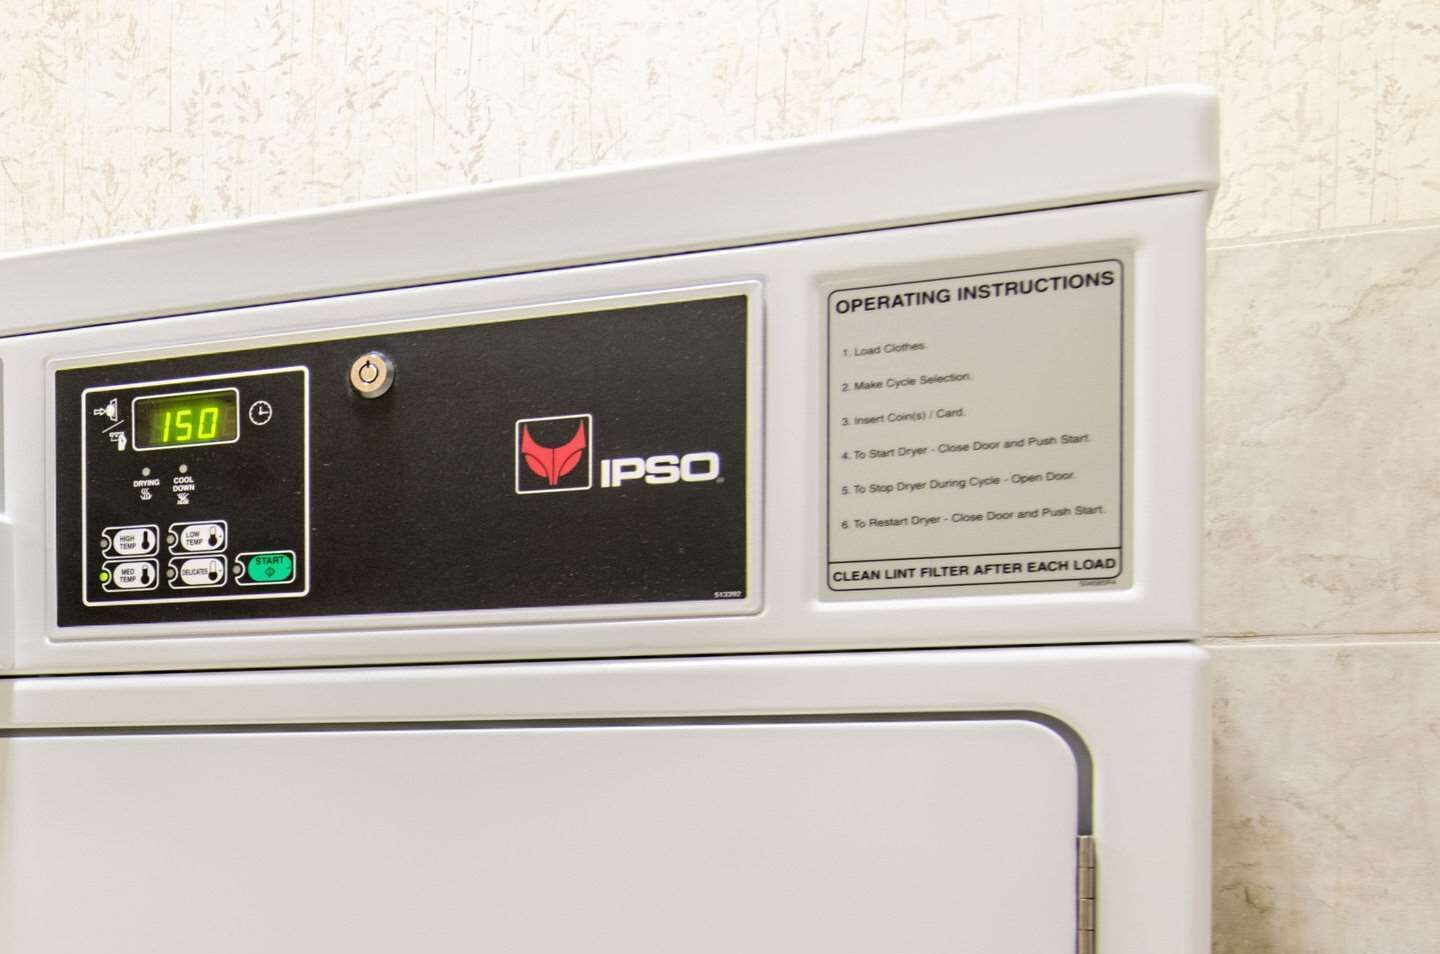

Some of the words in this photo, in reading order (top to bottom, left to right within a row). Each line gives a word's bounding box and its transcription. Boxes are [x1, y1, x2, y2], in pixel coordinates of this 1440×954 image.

[836, 289, 950, 314] OPERATING
[958, 270, 1114, 300] INSTRUCTIONS
[843, 348, 851, 357] 1.
[854, 346, 880, 357] Load
[884, 342, 927, 353] Clothes.
[842, 383, 851, 392] 2.
[854, 380, 882, 391] Make
[886, 378, 916, 389] Cycle
[920, 372, 974, 384] Selection.
[162, 407, 219, 442] 150
[842, 418, 851, 426] 3.
[854, 414, 884, 425] Insert
[888, 411, 926, 422] Coin(s)
[936, 407, 966, 419] Card.
[841, 452, 850, 460] 4.
[854, 451, 866, 459] To
[869, 449, 894, 458] Start
[898, 447, 927, 458] Dryer
[938, 443, 969, 453] Close
[973, 440, 1000, 450] Door
[1004, 438, 1024, 448] and
[1028, 437, 1057, 446] Push
[1060, 434, 1092, 444] Start.
[173, 476, 194, 484] COOL
[600, 452, 720, 488] IPSO
[133, 479, 160, 487] DRYING
[172, 484, 195, 492] DOWN
[842, 486, 850, 495] 5.
[854, 485, 866, 493] To
[869, 484, 894, 494] Stop
[896, 482, 926, 493] Dryer
[929, 479, 966, 489] During
[969, 476, 1000, 488] Cycle
[1011, 474, 1042, 484] Open
[1046, 472, 1076, 481] Door.
[842, 521, 850, 529] 6.
[854, 520, 866, 528] To
[869, 518, 908, 527] Restart
[911, 516, 941, 526] Dryer
[951, 513, 983, 522] Close
[986, 511, 1013, 520] Door
[1017, 509, 1038, 519] and
[1042, 507, 1071, 517] Push
[1075, 505, 1106, 515] Start.
[255, 556, 284, 565] START
[833, 570, 881, 582] CLEAN
[884, 568, 916, 579] LINT
[920, 566, 969, 578] FILTER
[974, 563, 1022, 575] AFTER
[1027, 560, 1069, 572] EACH
[1073, 558, 1116, 570] LOAD
